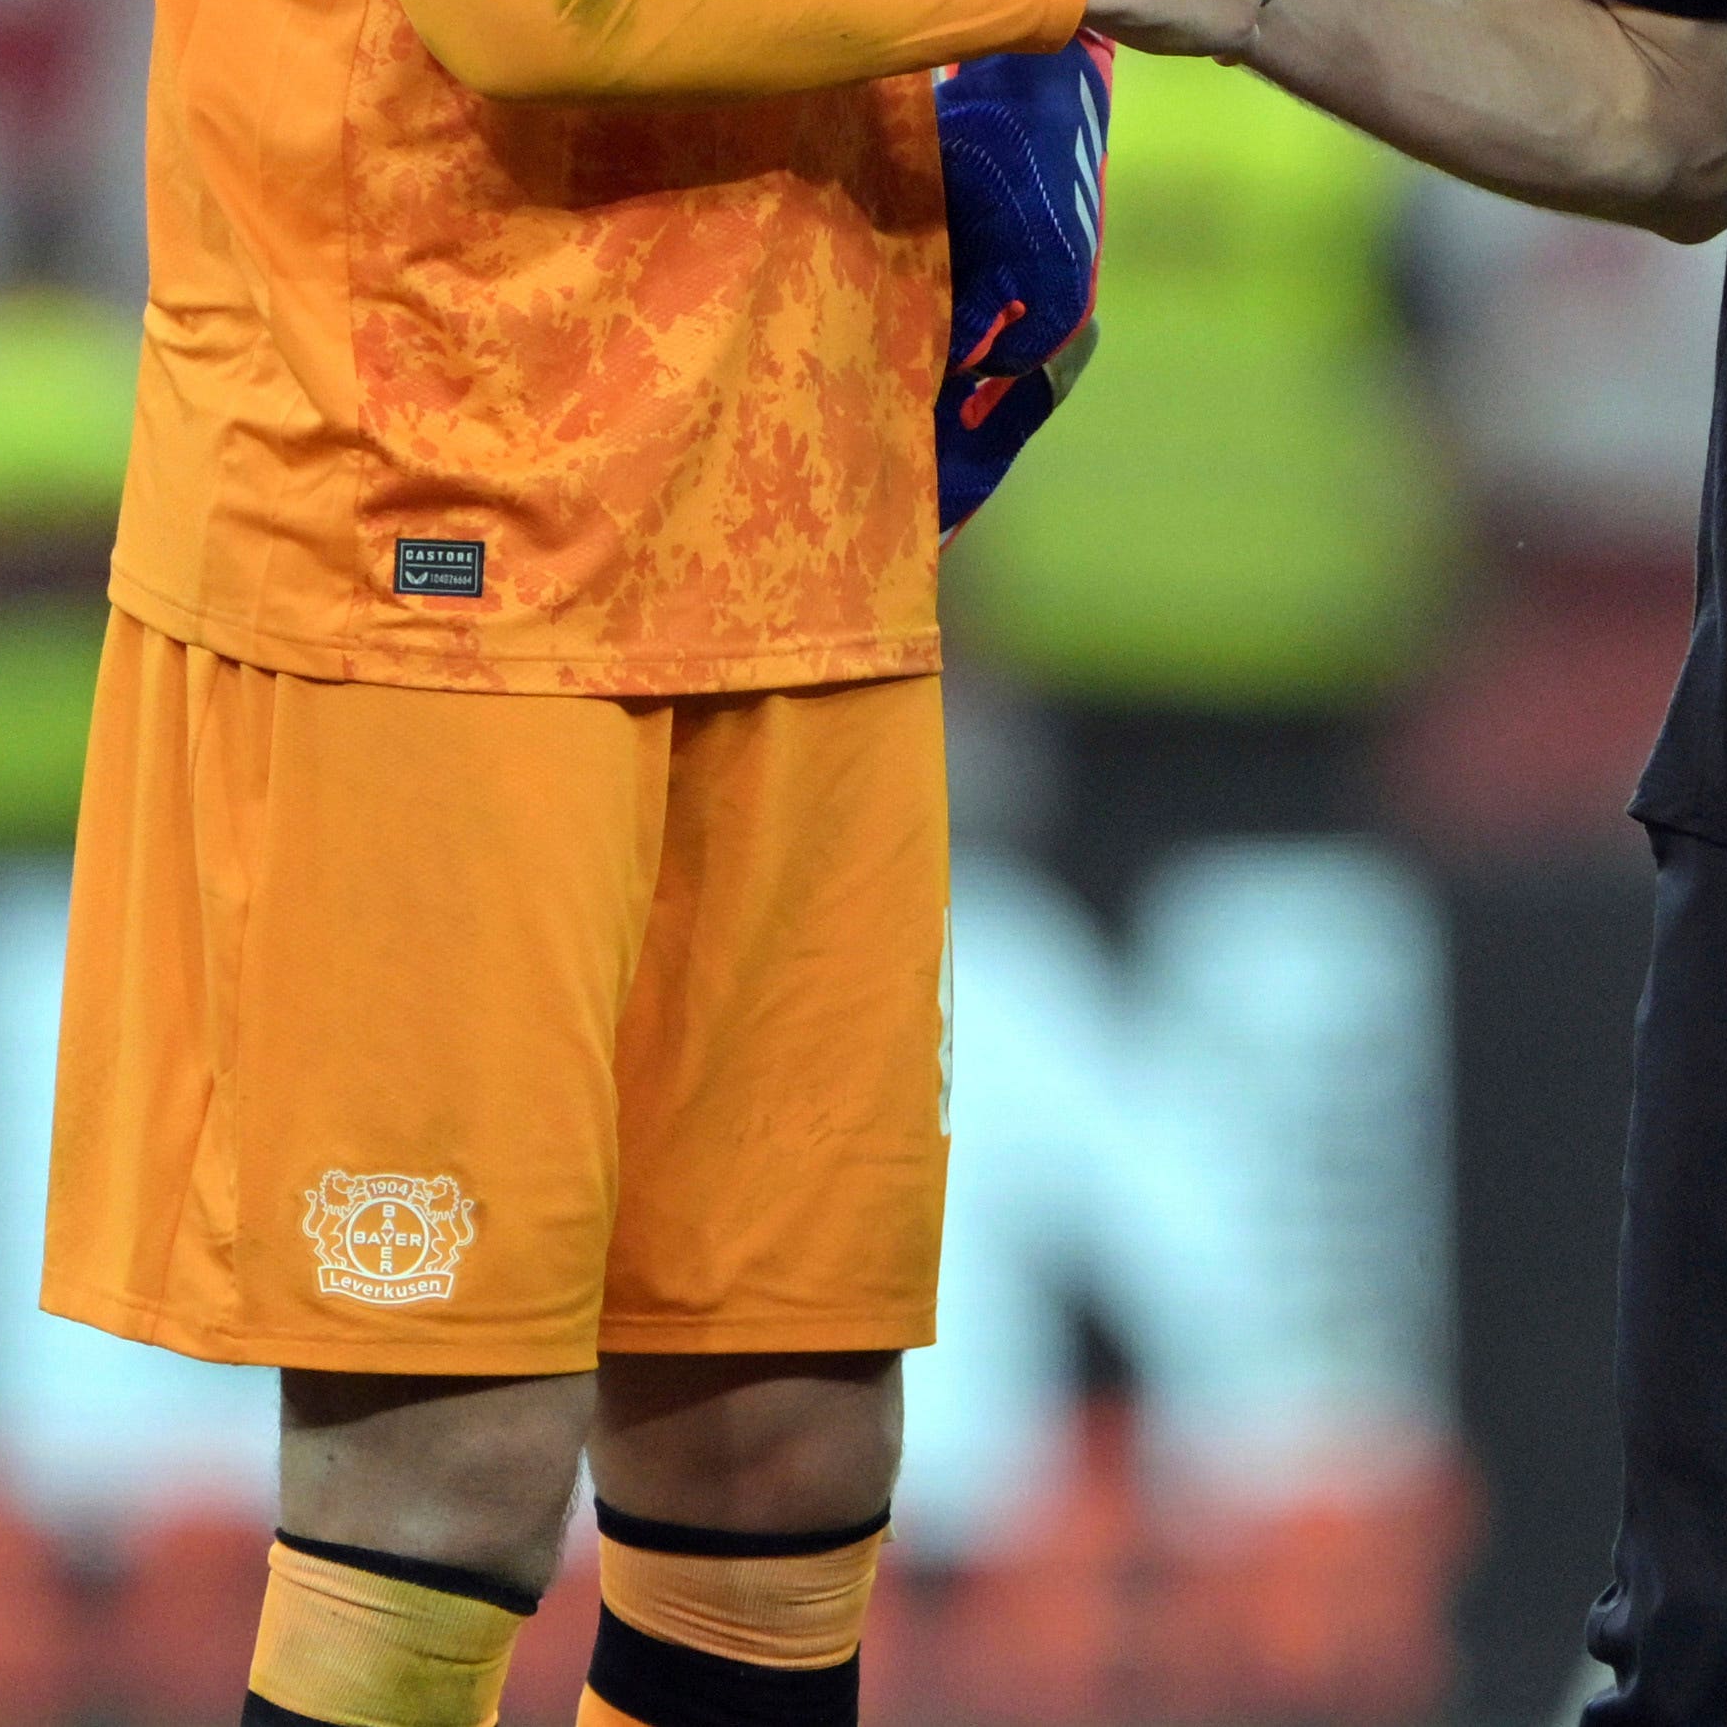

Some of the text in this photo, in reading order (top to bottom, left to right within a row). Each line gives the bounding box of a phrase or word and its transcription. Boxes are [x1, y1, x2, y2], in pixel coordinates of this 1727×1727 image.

[405, 549, 473, 563] CASTORE
[369, 1181, 409, 1197] 1904
[353, 1232, 423, 1248] BAYER
[380, 1204, 396, 1274] BAYER
[329, 1271, 441, 1299] Leverkusen
